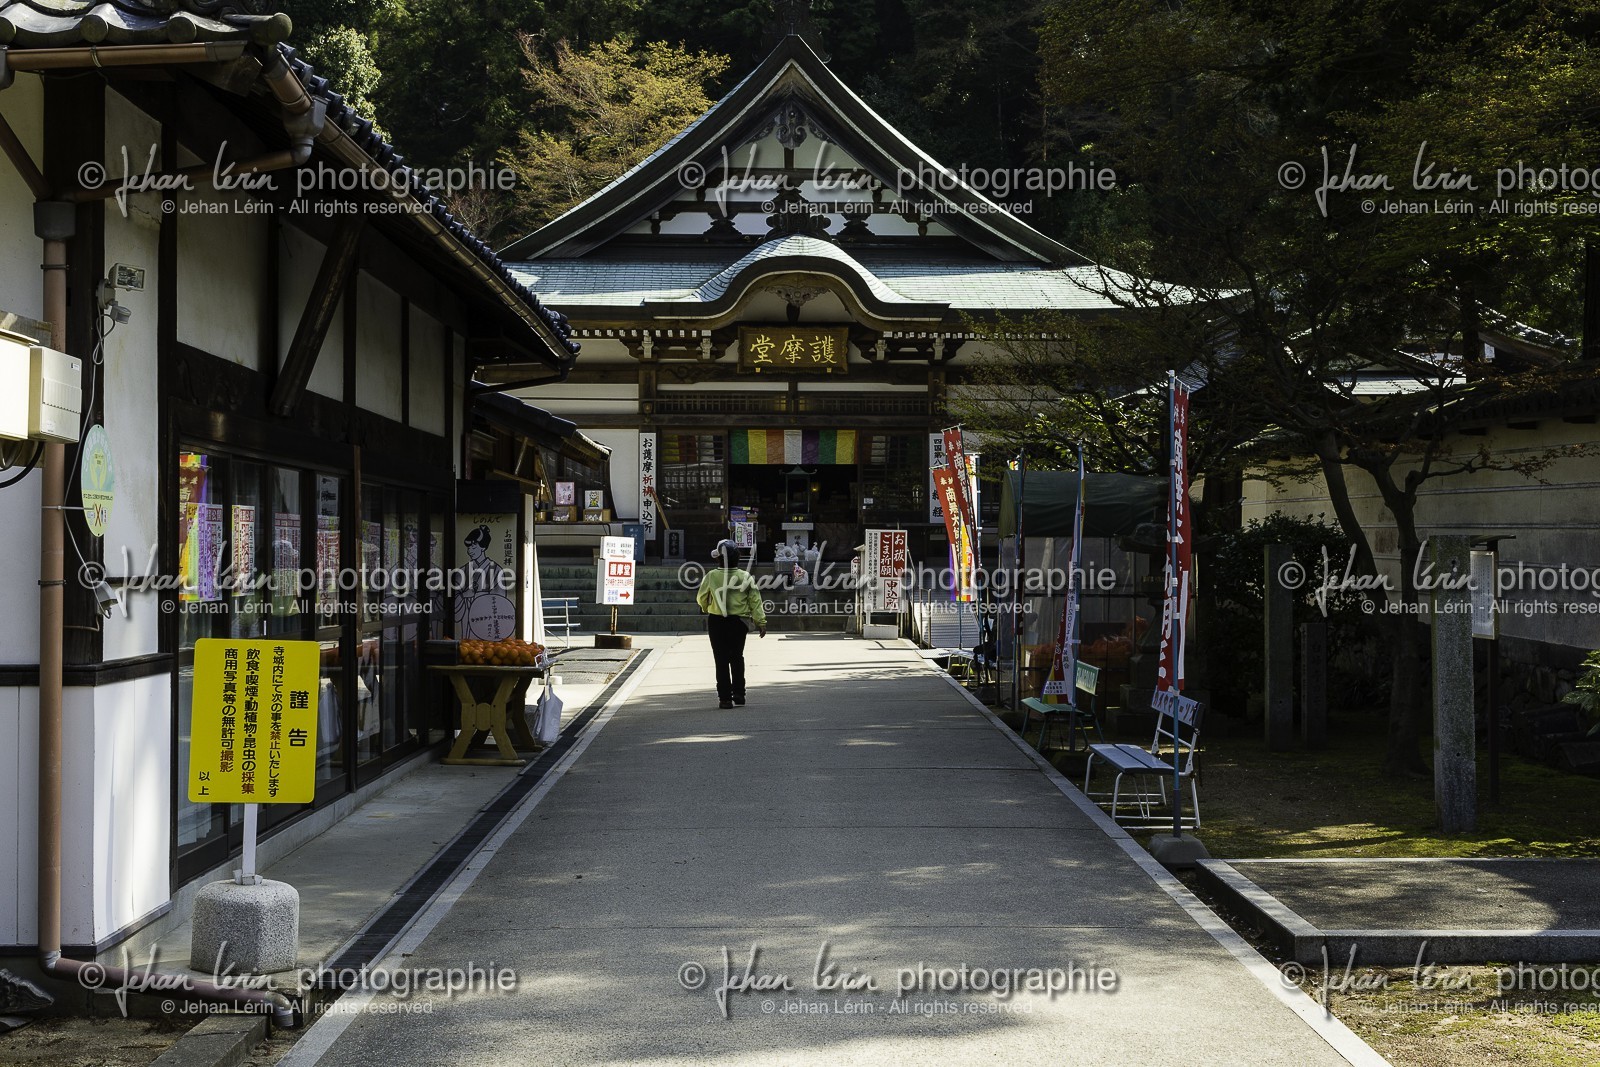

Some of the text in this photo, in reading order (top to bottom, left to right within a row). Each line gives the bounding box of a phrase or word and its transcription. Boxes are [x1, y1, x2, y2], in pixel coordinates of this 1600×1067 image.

[750, 334, 838, 365] 護摩堂
[219, 648, 238, 773] 商用写真等の無許可撮影
